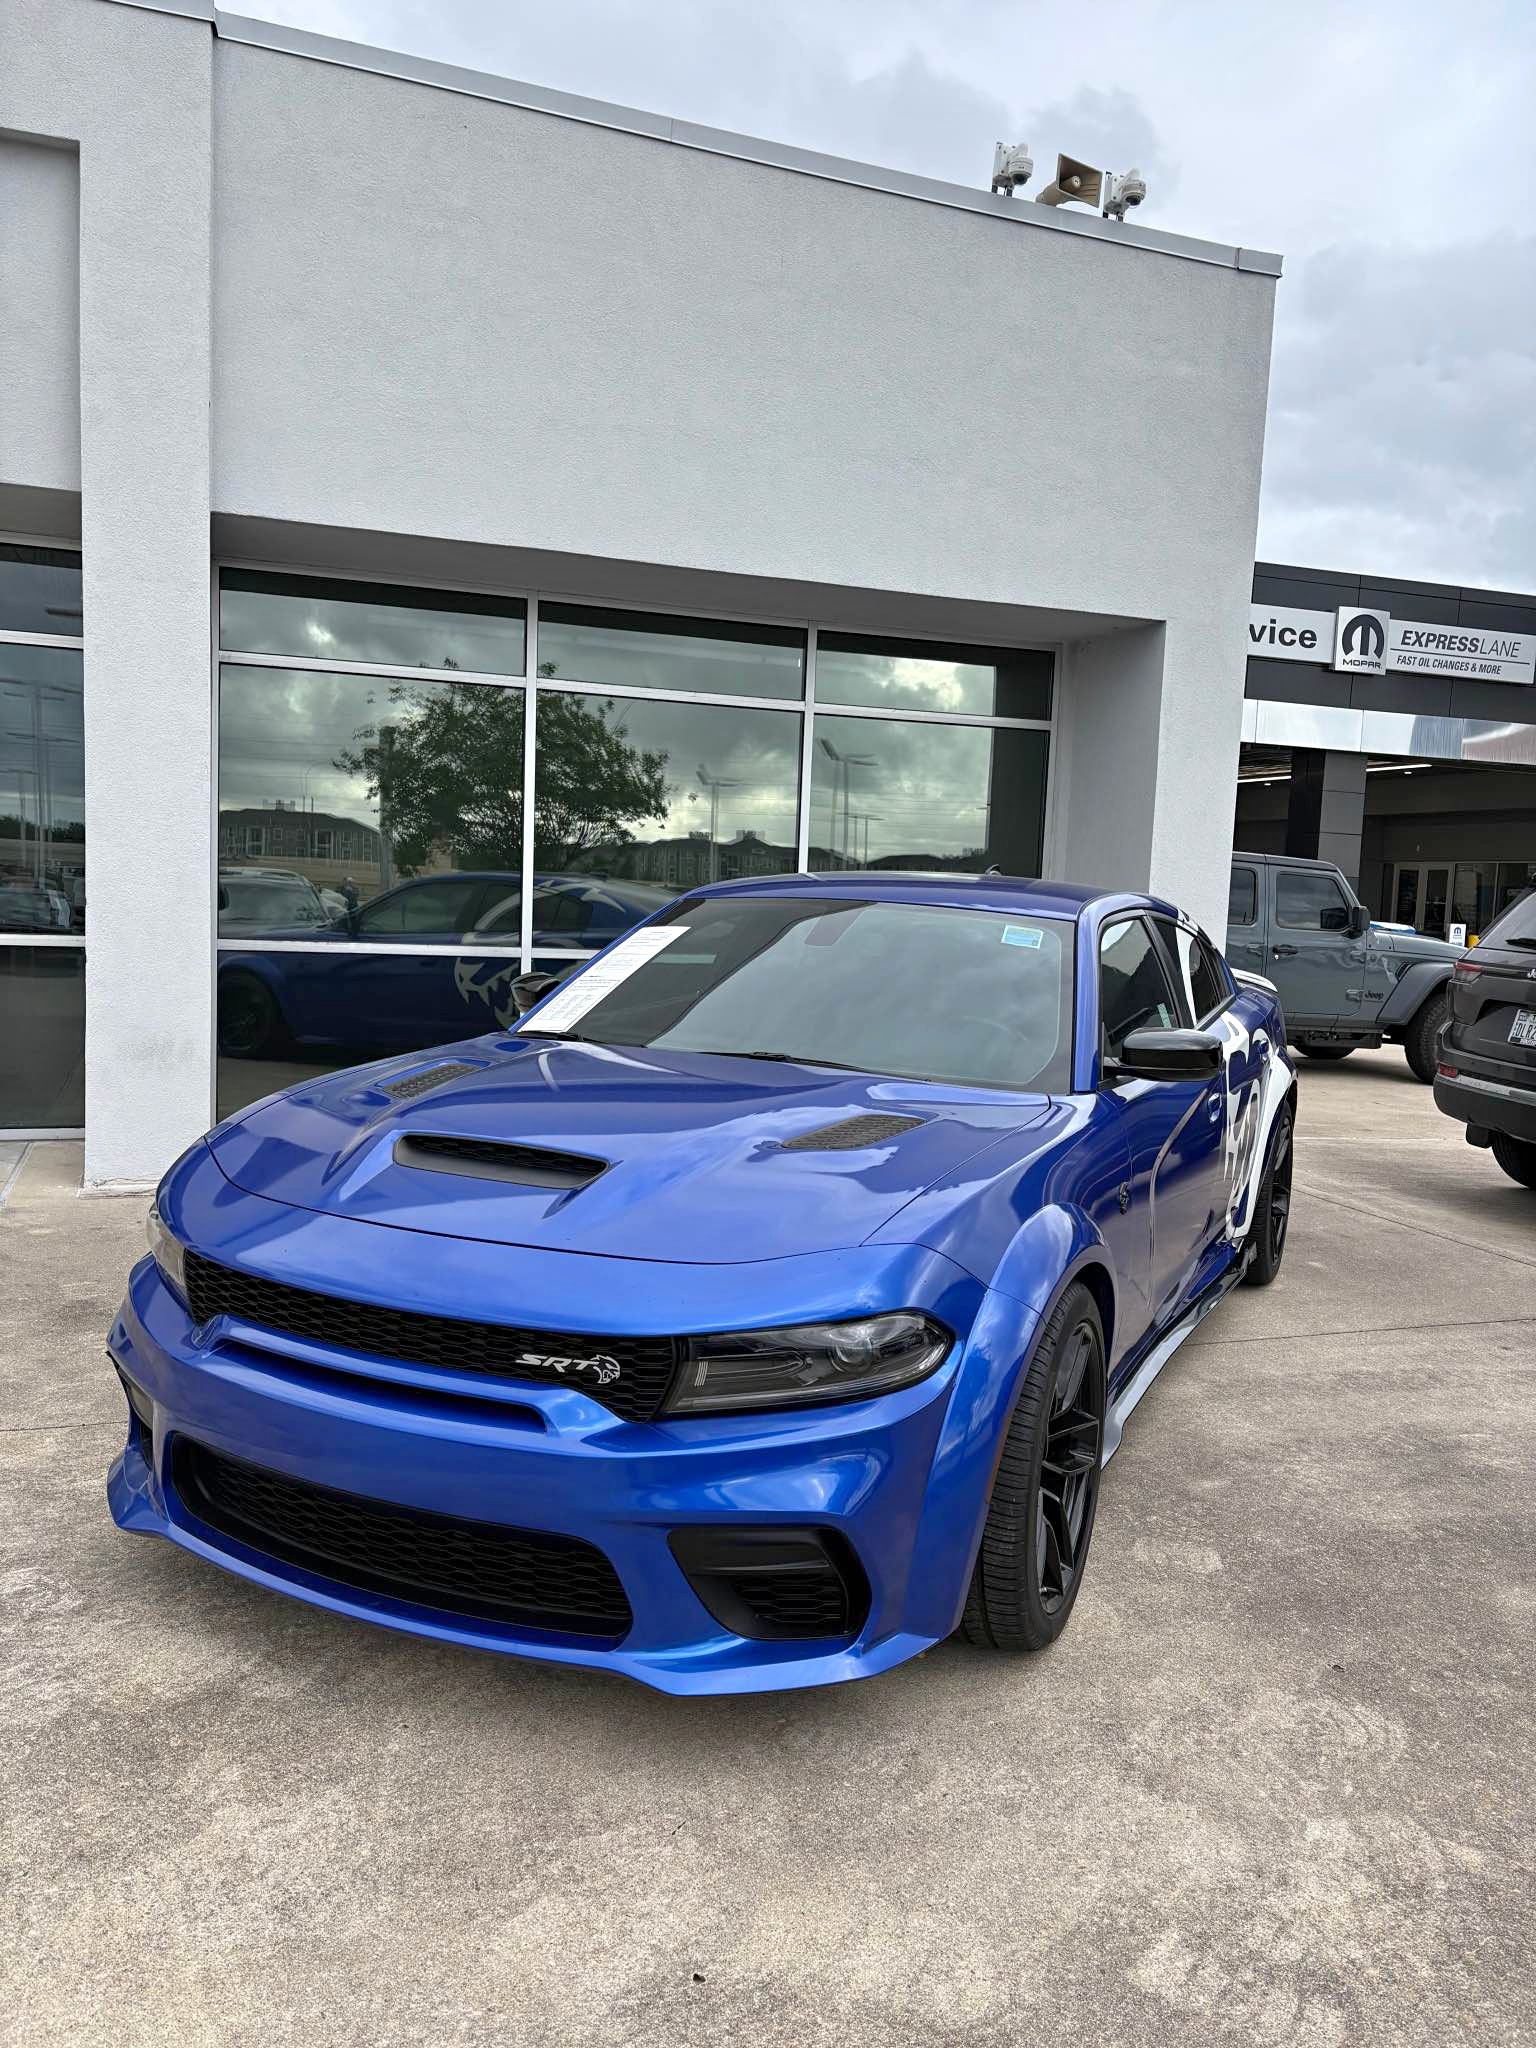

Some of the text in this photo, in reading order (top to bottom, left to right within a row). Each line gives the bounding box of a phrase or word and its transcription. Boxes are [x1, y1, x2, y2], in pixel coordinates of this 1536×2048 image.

[1342, 658, 1382, 669] MOPAR
[1397, 655, 1502, 675] FAST OIL CHANGES & MORE
[515, 1353, 599, 1373] SRT
